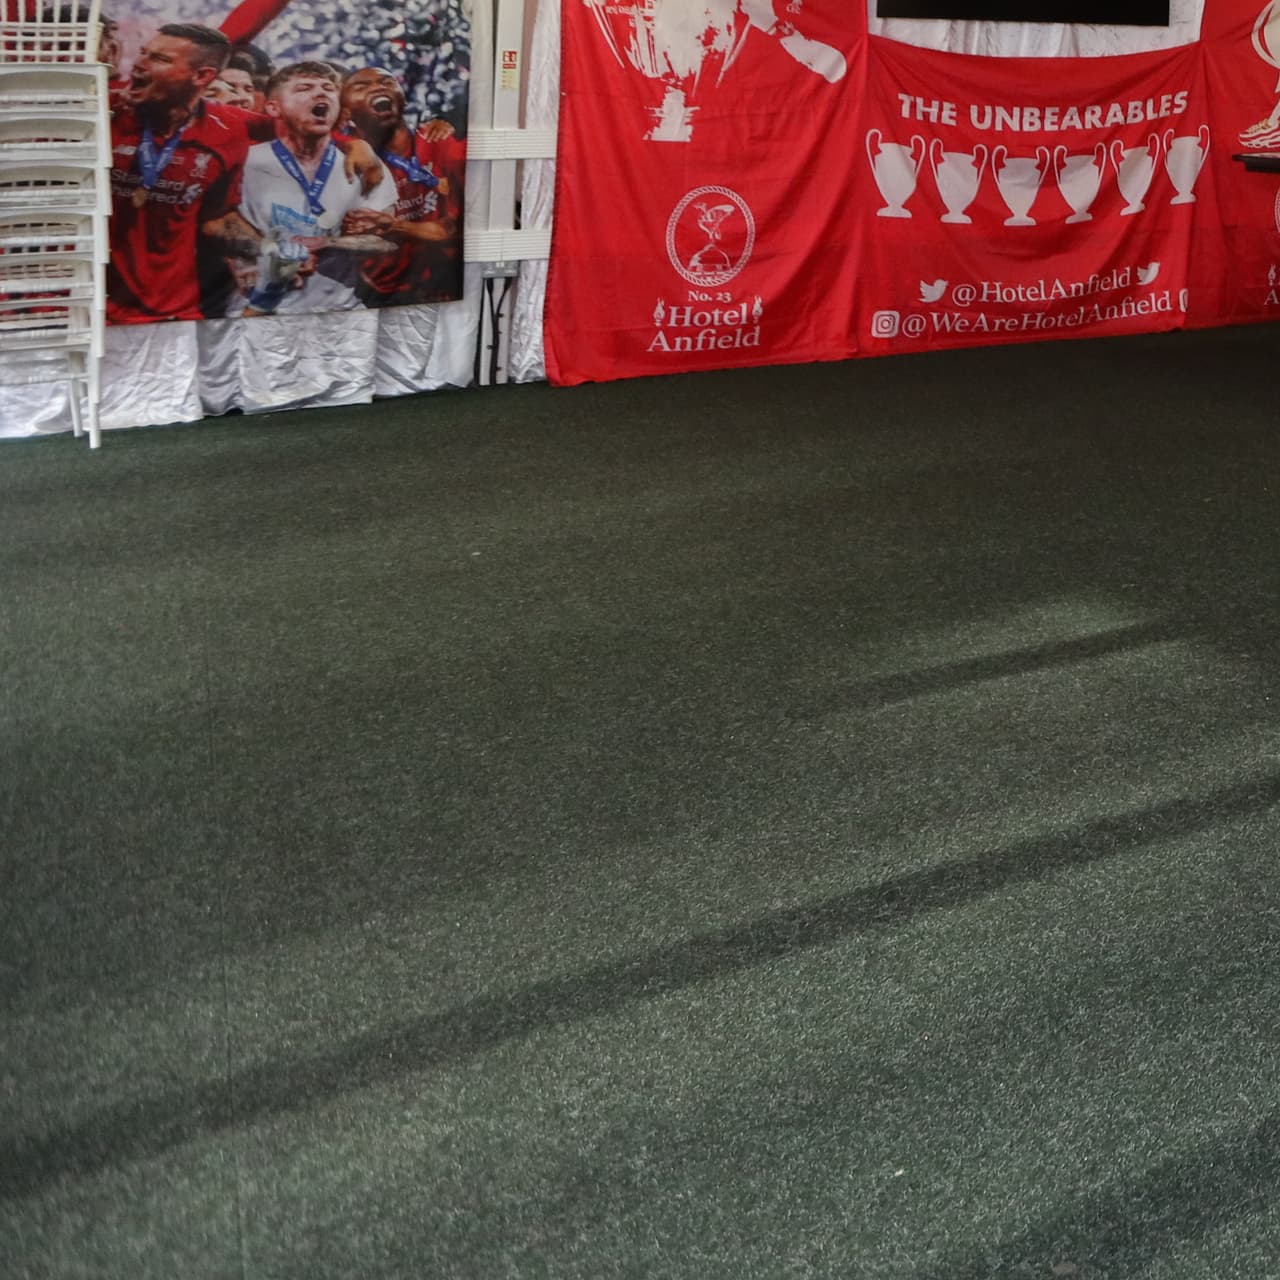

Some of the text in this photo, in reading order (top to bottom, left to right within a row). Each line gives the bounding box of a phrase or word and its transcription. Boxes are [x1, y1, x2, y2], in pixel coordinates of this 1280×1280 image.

[897, 90, 1189, 132] THE UNBEARABLES
[687, 290, 732, 303] No. 23
[951, 266, 1131, 307] @HotelAnfield
[666, 302, 748, 328] Hotel
[901, 290, 1173, 339] @WeAreHotelAnfield
[646, 324, 761, 352] Anfield
